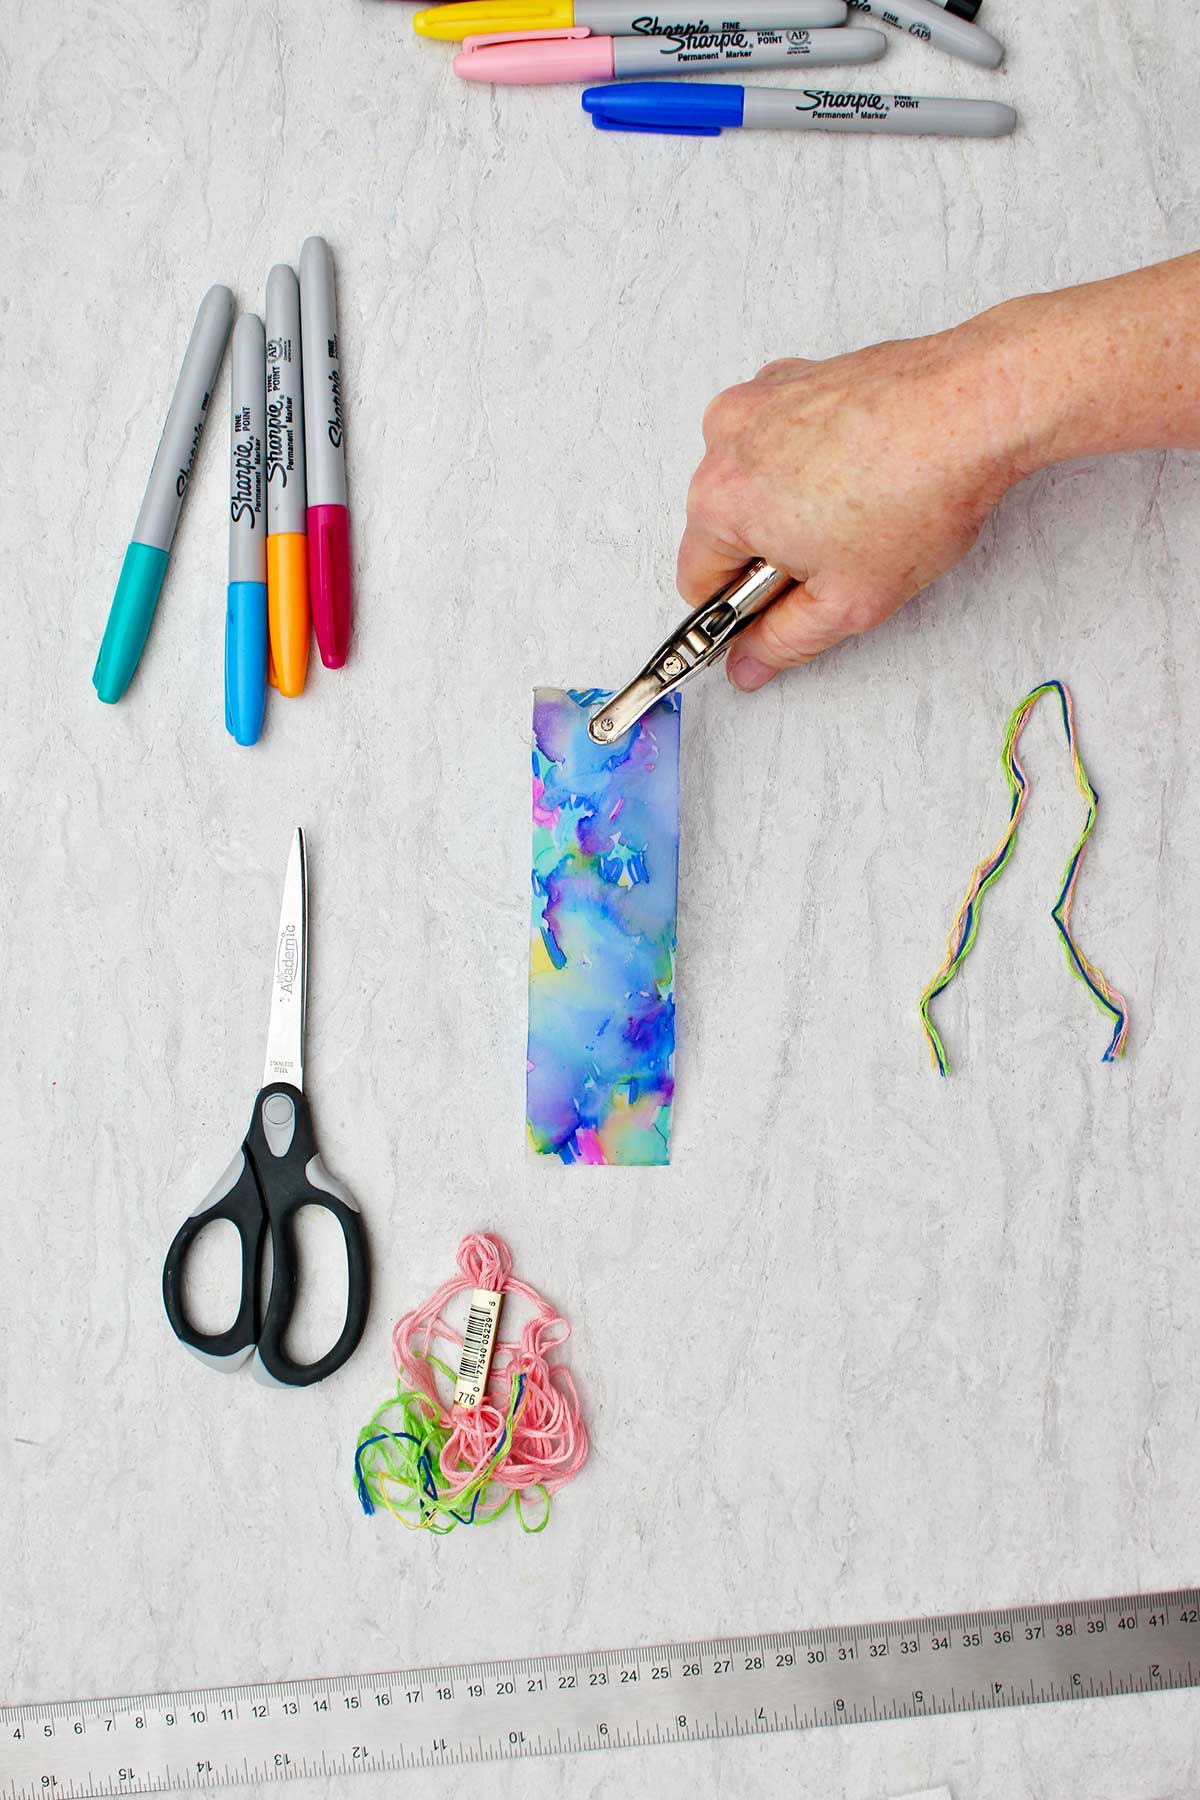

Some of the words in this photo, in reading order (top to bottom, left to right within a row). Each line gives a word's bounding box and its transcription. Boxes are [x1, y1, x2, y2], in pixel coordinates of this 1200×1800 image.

[721, 22, 741, 30] FINE
[757, 36, 783, 45] POINT
[678, 52, 719, 62] Permanent
[726, 50, 753, 59] Marker
[795, 90, 885, 113] Sharpie
[812, 111, 853, 119] Permanent
[861, 112, 888, 120] Marker
[272, 366, 281, 391] POINT
[285, 397, 293, 423] Marker
[242, 406, 251, 432] POINT
[266, 401, 287, 488] Sharpie
[286, 430, 294, 470] Permanent
[254, 438, 262, 465] Marker
[231, 441, 256, 529] Sharpie
[254, 472, 262, 512] Permanent
[280, 924, 296, 994] Academic
[476, 1348, 487, 1375] 77540
[482, 1317, 493, 1345] 05229
[459, 1391, 476, 1405] 776
[13, 1729, 21, 1740] 4
[44, 1725, 53, 1737] 5
[74, 1723, 82, 1734] 6
[104, 1720, 112, 1731] 7
[135, 1717, 144, 1729] 8
[165, 1714, 174, 1726] 9
[190, 1711, 205, 1723] 10
[221, 1709, 233, 1720] 11
[252, 1706, 267, 1718] 12
[282, 1703, 297, 1715] 13
[313, 1700, 328, 1712] 14
[344, 1697, 359, 1709] 15
[375, 1694, 390, 1706] 16
[406, 1691, 420, 1703] 17
[437, 1688, 452, 1700] 18
[467, 1685, 482, 1697] 19
[496, 1682, 513, 1695] 20
[527, 1680, 543, 1692] 21
[558, 1676, 575, 1689] 22
[589, 1673, 607, 1686] 23
[620, 1670, 638, 1683] 24
[651, 1667, 669, 1680] 25
[682, 1664, 700, 1677] 26
[713, 1661, 731, 1673] 27
[745, 1658, 762, 1670] 28
[776, 1654, 793, 1667] 29
[807, 1651, 824, 1664] 30
[838, 1648, 855, 1661] 31
[869, 1644, 887, 1657] 32
[900, 1641, 918, 1654] 33
[931, 1637, 949, 1650] 34
[962, 1634, 980, 1647] 35
[993, 1631, 1011, 1644] 36
[1025, 1627, 1042, 1640] 37
[1056, 1624, 1073, 1637] 38
[1087, 1620, 1104, 1633] 39
[1118, 1617, 1135, 1630] 40
[1149, 1614, 1165, 1627] 41
[1180, 1610, 1198, 1623] 42
[1151, 1664, 1160, 1676] 2
[1072, 1673, 1081, 1685] 3
[994, 1682, 1002, 1694] 4
[914, 1690, 923, 1702] 5
[836, 1698, 845, 1711] 6
[758, 1707, 766, 1719] 7
[678, 1715, 687, 1727] 8
[599, 1723, 608, 1735] 9
[509, 1731, 525, 1744] 10
[433, 1739, 447, 1751] 11
[352, 1746, 368, 1758] 12
[274, 1753, 291, 1766] 13
[197, 1760, 213, 1772] 14
[118, 1768, 135, 1780] 15
[41, 1775, 57, 1787] 16
